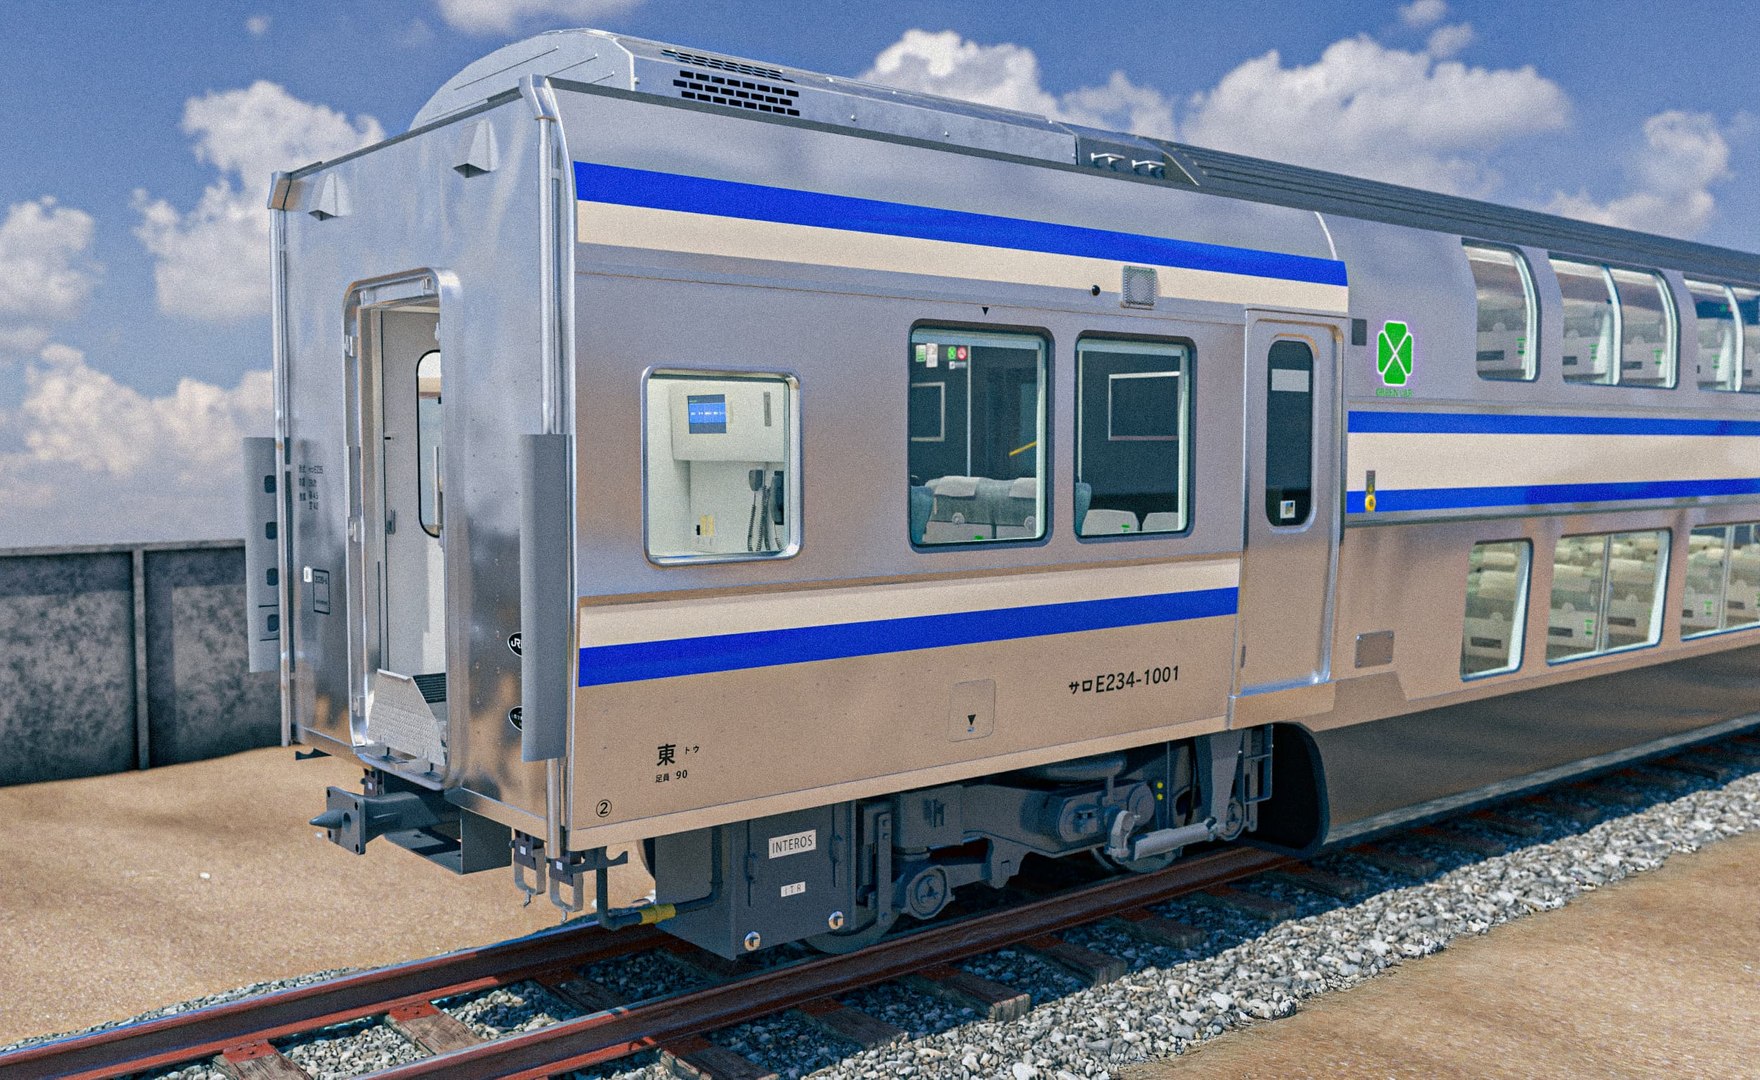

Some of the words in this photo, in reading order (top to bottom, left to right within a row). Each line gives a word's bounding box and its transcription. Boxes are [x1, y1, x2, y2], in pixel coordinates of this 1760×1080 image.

[1068, 665, 1179, 694] サロE234-1001
[656, 743, 676, 766] 東
[675, 769, 688, 780] 90
[772, 834, 813, 854] INTEROS
